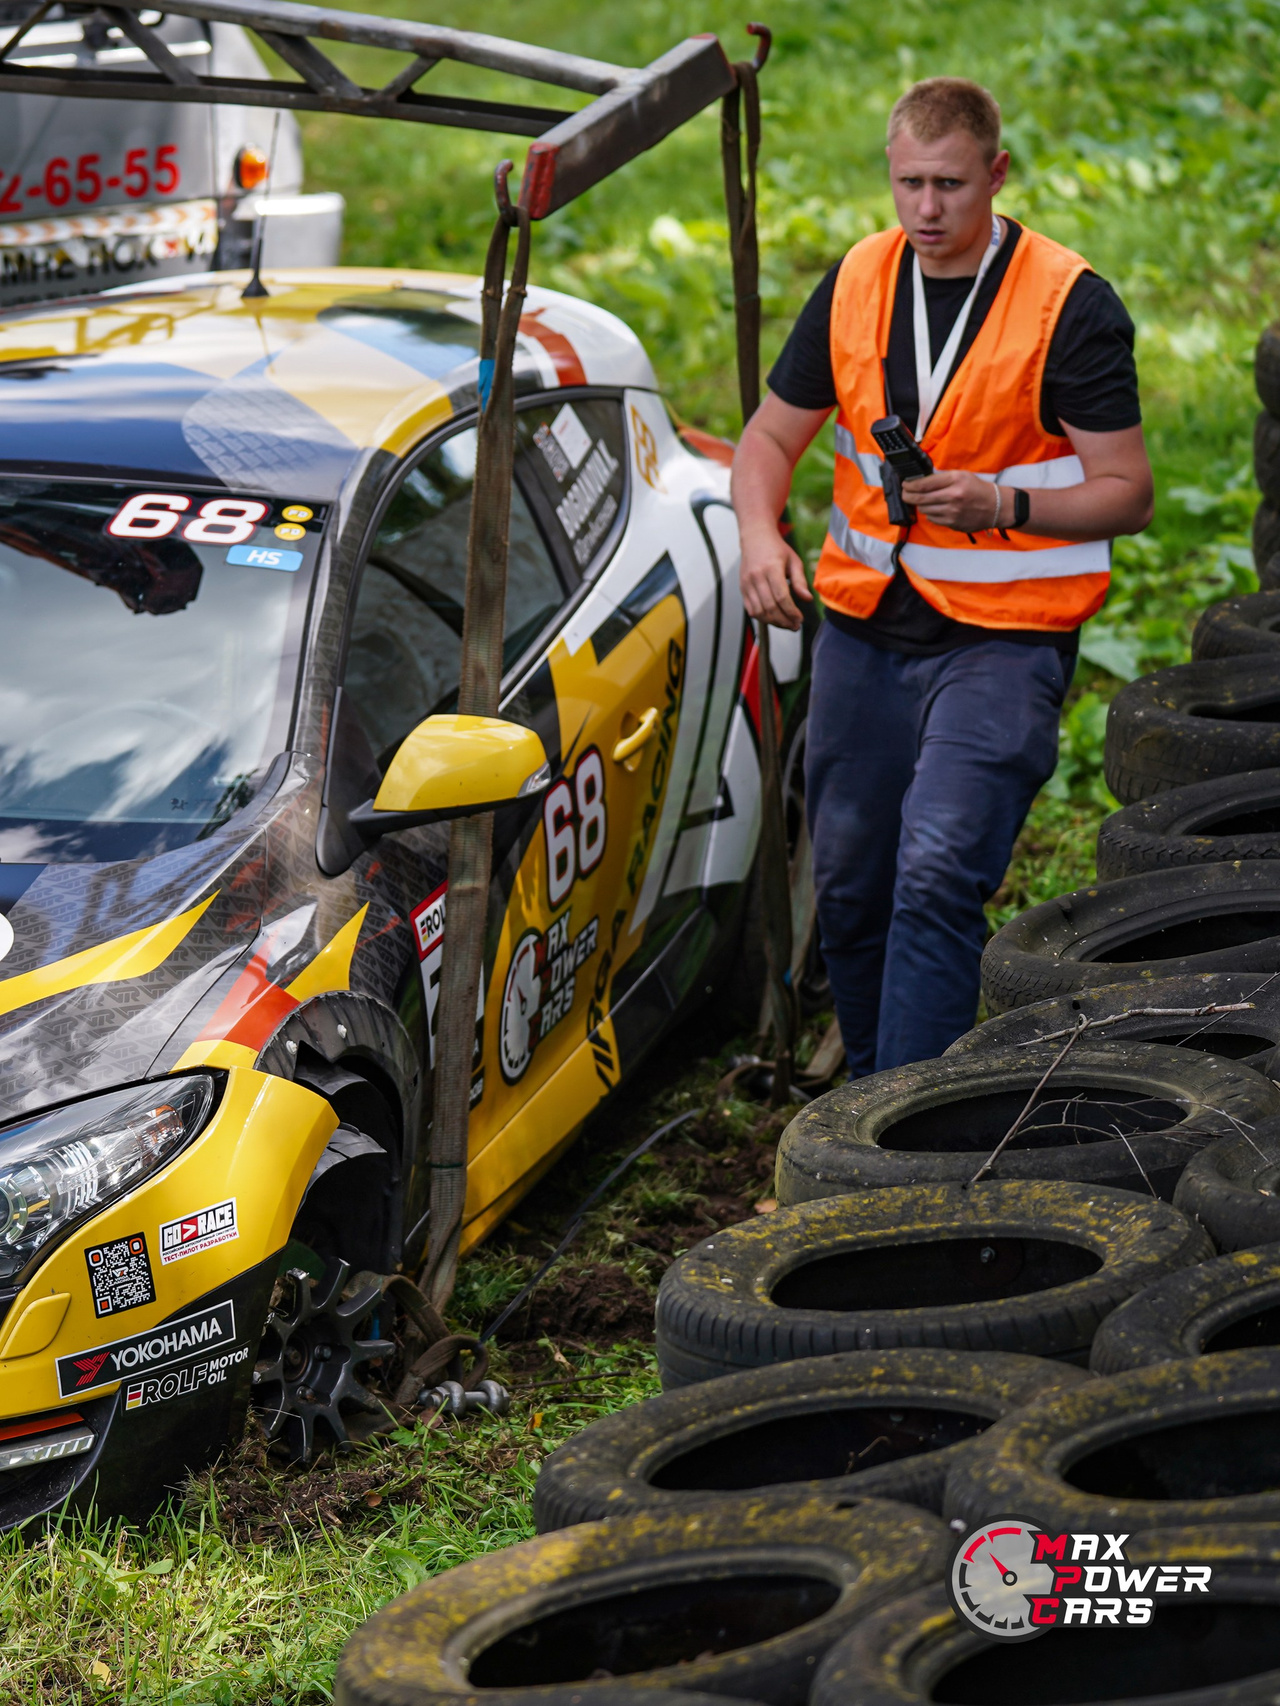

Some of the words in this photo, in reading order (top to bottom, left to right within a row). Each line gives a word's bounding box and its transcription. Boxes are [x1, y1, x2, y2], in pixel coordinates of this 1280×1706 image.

[107, 492, 268, 544] 68
[246, 549, 283, 566] HS
[544, 747, 606, 906] 68
[534, 909, 570, 979] MAX
[539, 917, 599, 1002] POWER
[527, 975, 576, 1050] CARS
[163, 1245, 199, 1263] ТЕСТ-ПИЛОТ
[199, 1231, 238, 1249] РАЗРАБОТКИ
[110, 1317, 222, 1372] YOKOHAMA
[140, 1362, 209, 1406] ROLF
[209, 1347, 249, 1373] MOTOR
[207, 1371, 227, 1385] OIL
